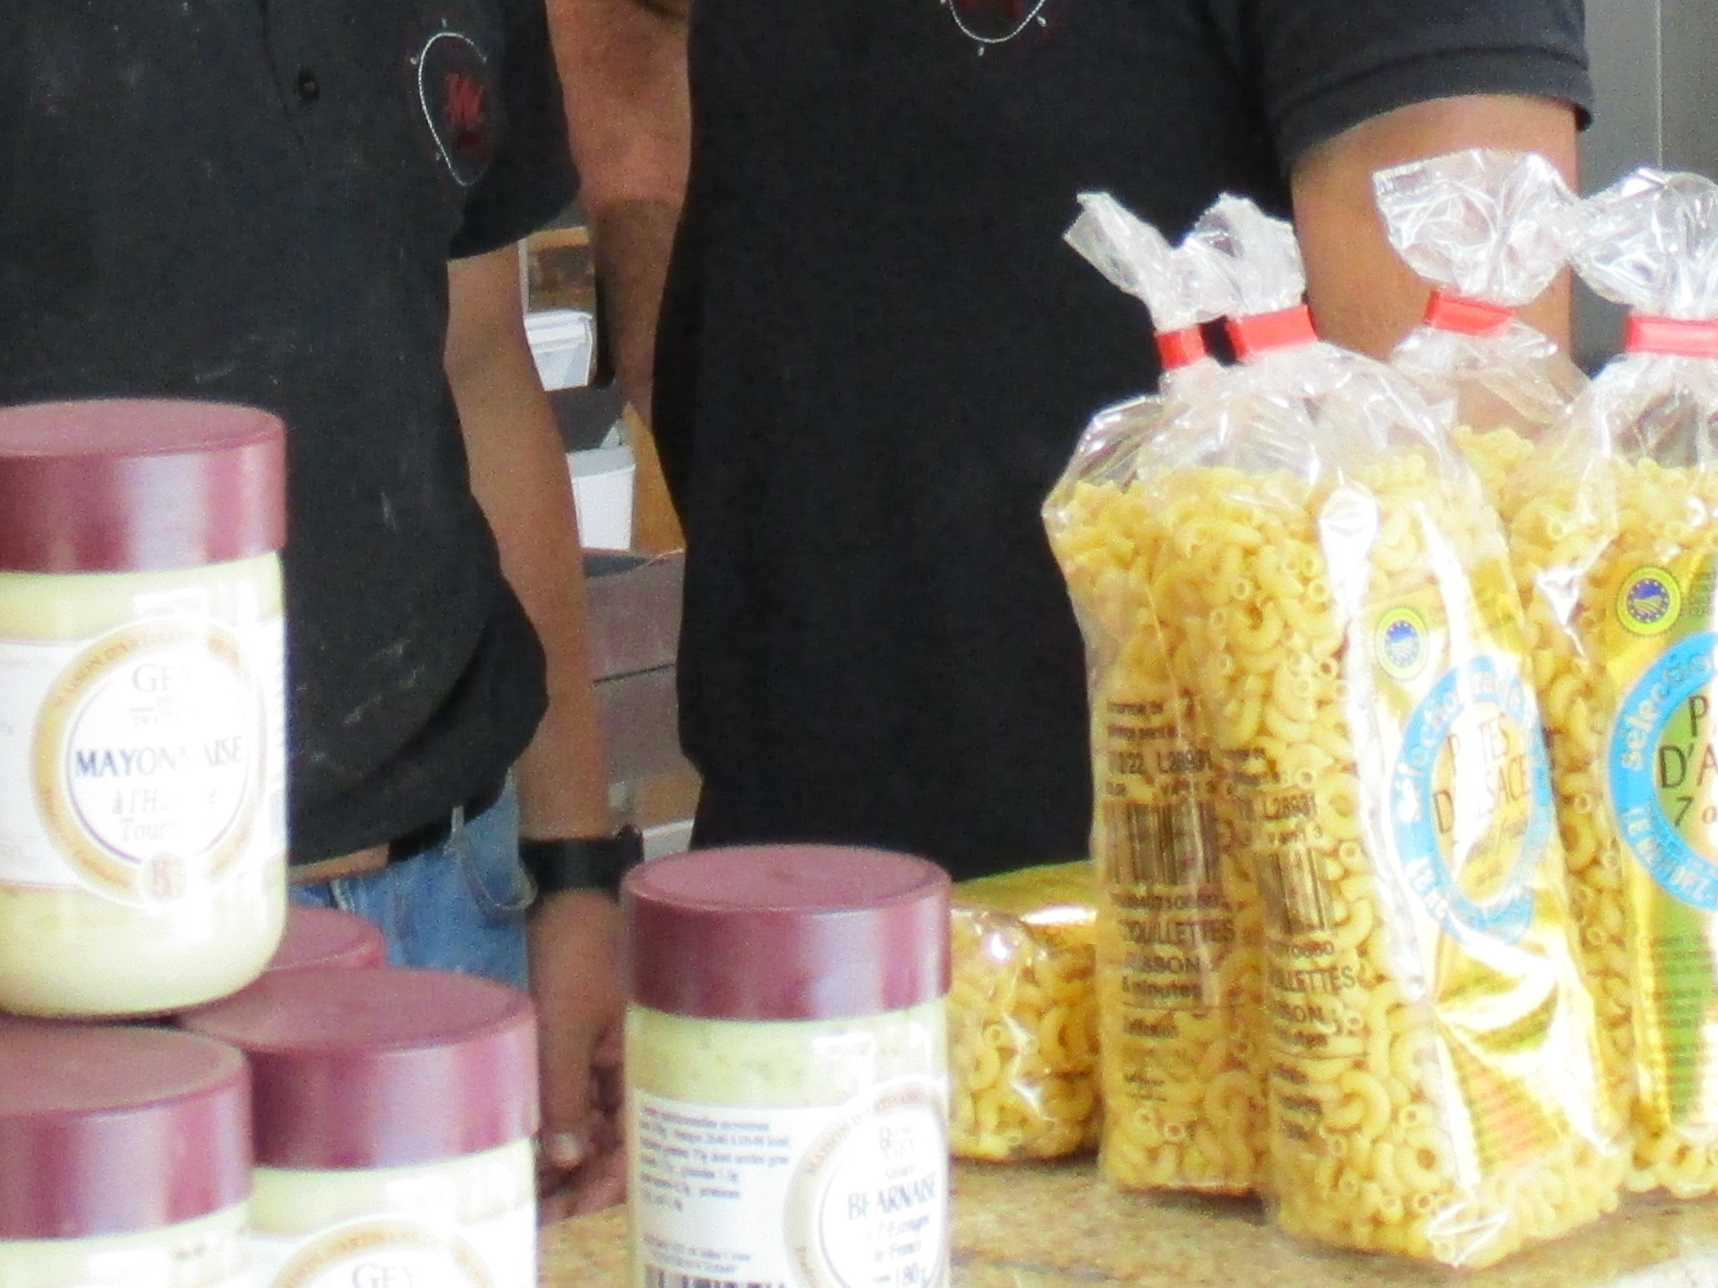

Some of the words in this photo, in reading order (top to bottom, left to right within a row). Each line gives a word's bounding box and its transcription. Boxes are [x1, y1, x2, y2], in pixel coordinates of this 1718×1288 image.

[75, 736, 243, 778] MAYONAISE
[1447, 712, 1510, 774] PTES
[1673, 795, 1693, 828] 7
